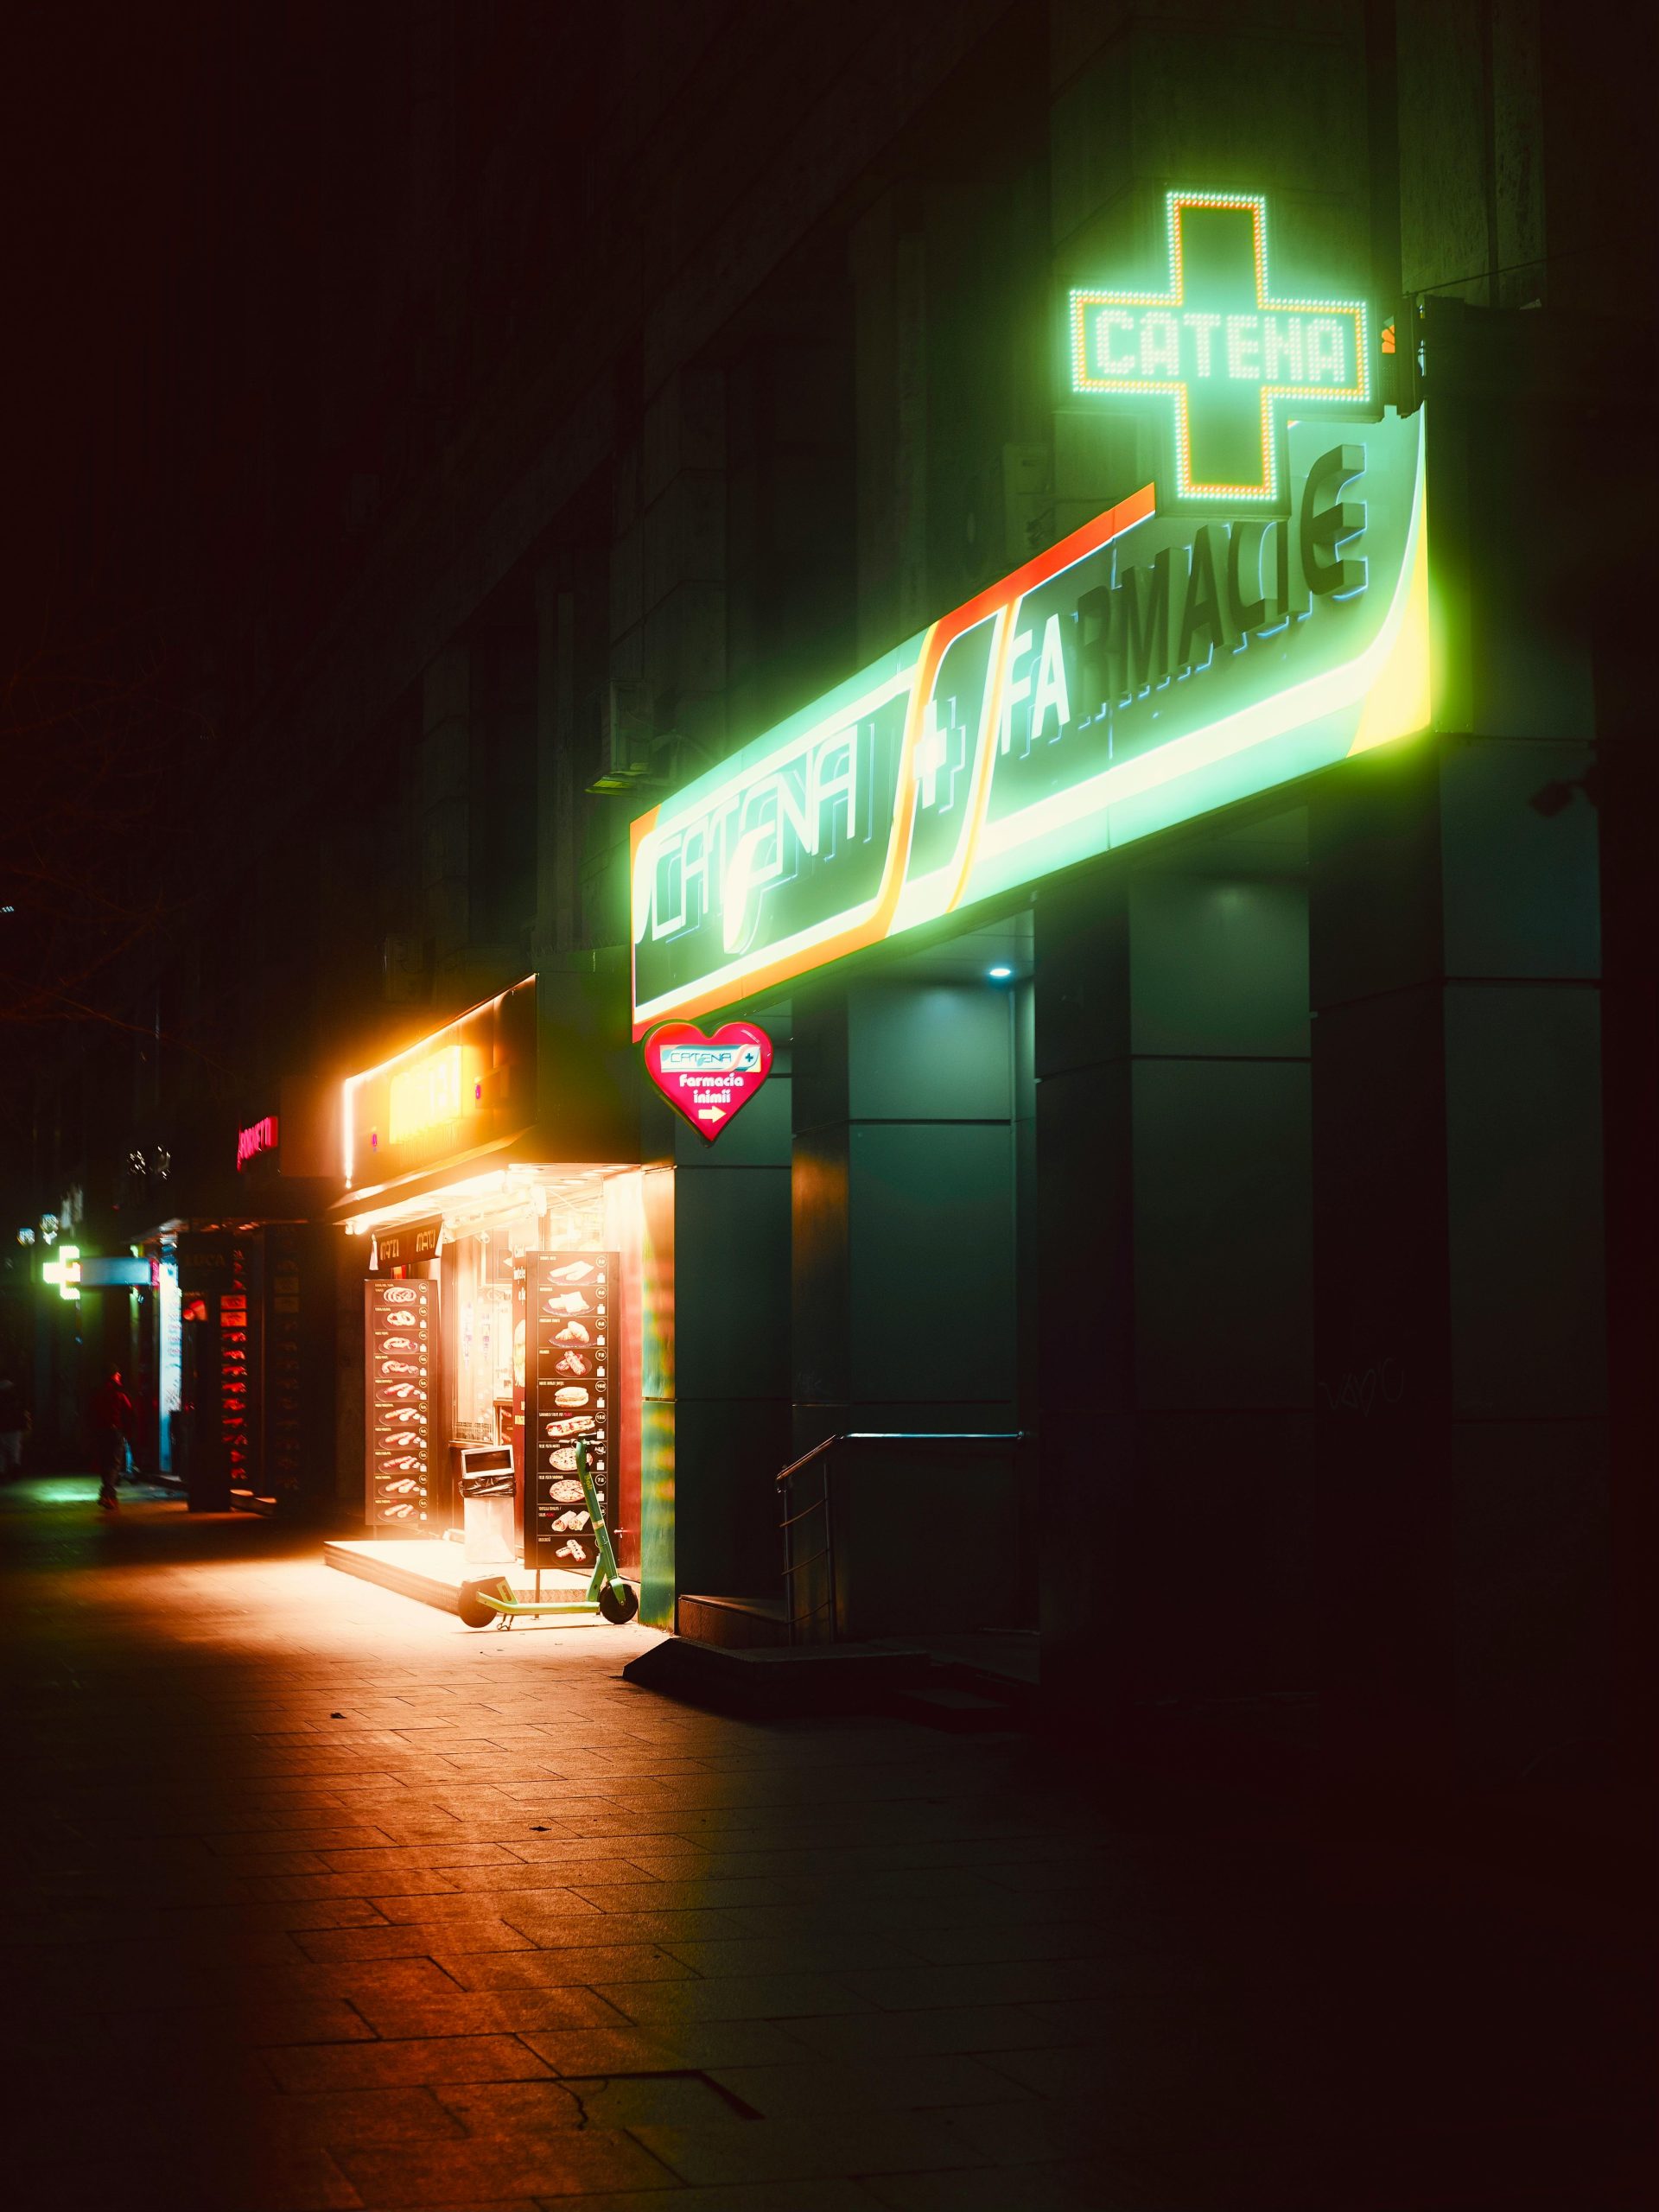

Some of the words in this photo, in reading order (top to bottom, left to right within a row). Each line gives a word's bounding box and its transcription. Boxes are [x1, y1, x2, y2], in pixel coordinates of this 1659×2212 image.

[1096, 309, 1345, 383] CATENA
[1000, 444, 1368, 756] FARMACIE
[671, 1052, 732, 1063] CATENA
[693, 1089, 731, 1103] inimii
